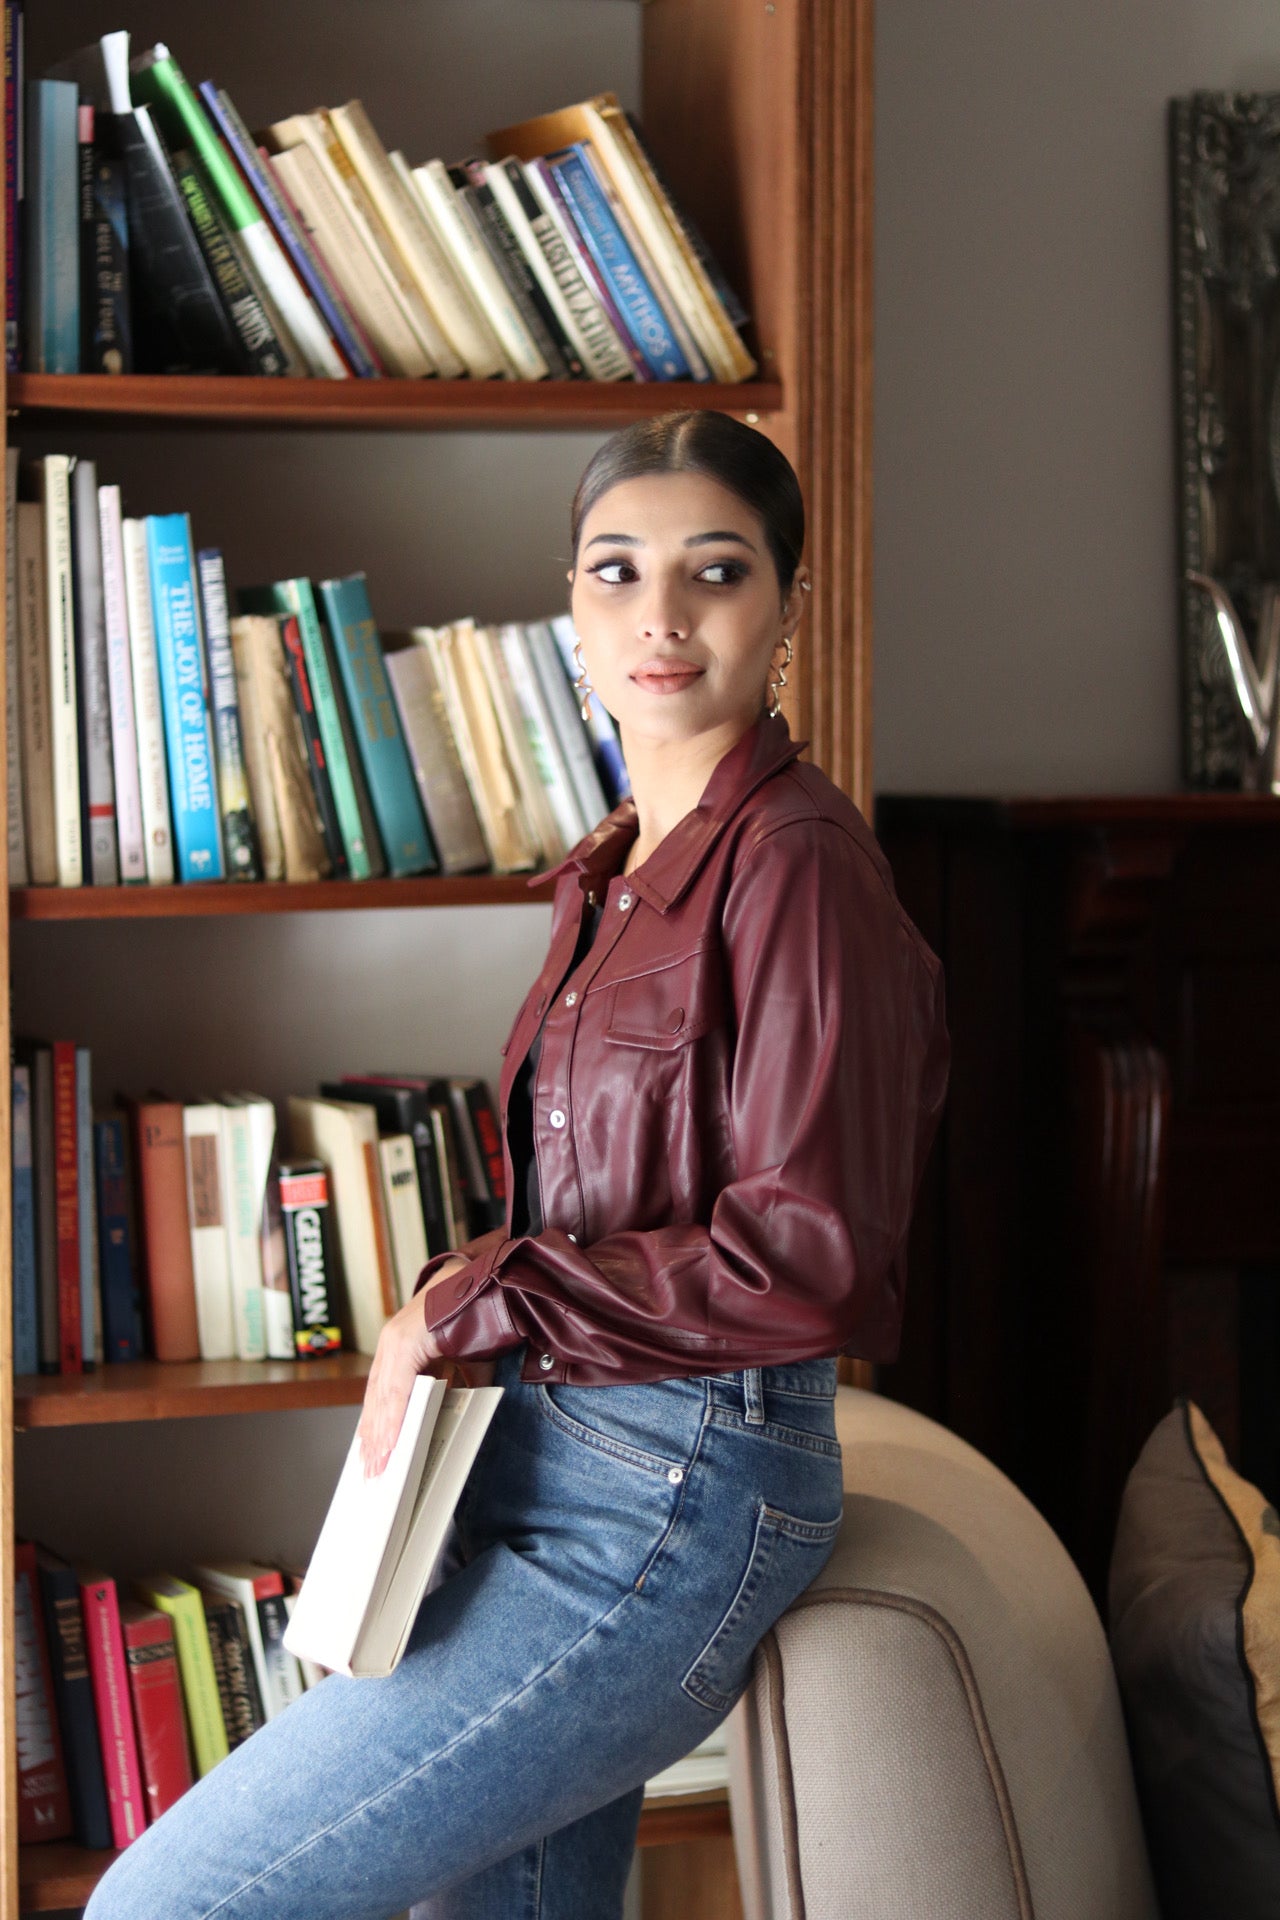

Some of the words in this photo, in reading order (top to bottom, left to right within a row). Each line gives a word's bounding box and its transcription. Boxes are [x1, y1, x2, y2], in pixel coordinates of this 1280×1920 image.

[95, 222, 113, 262] RULE
[97, 270, 114, 289] OF
[98, 298, 116, 341] FOUR
[612, 264, 671, 357] MYTHOS
[171, 581, 193, 637] THE
[175, 637, 198, 686] JOY
[179, 691, 205, 729] OF
[185, 731, 211, 810] HOME
[296, 1208, 327, 1324] GERMAN
